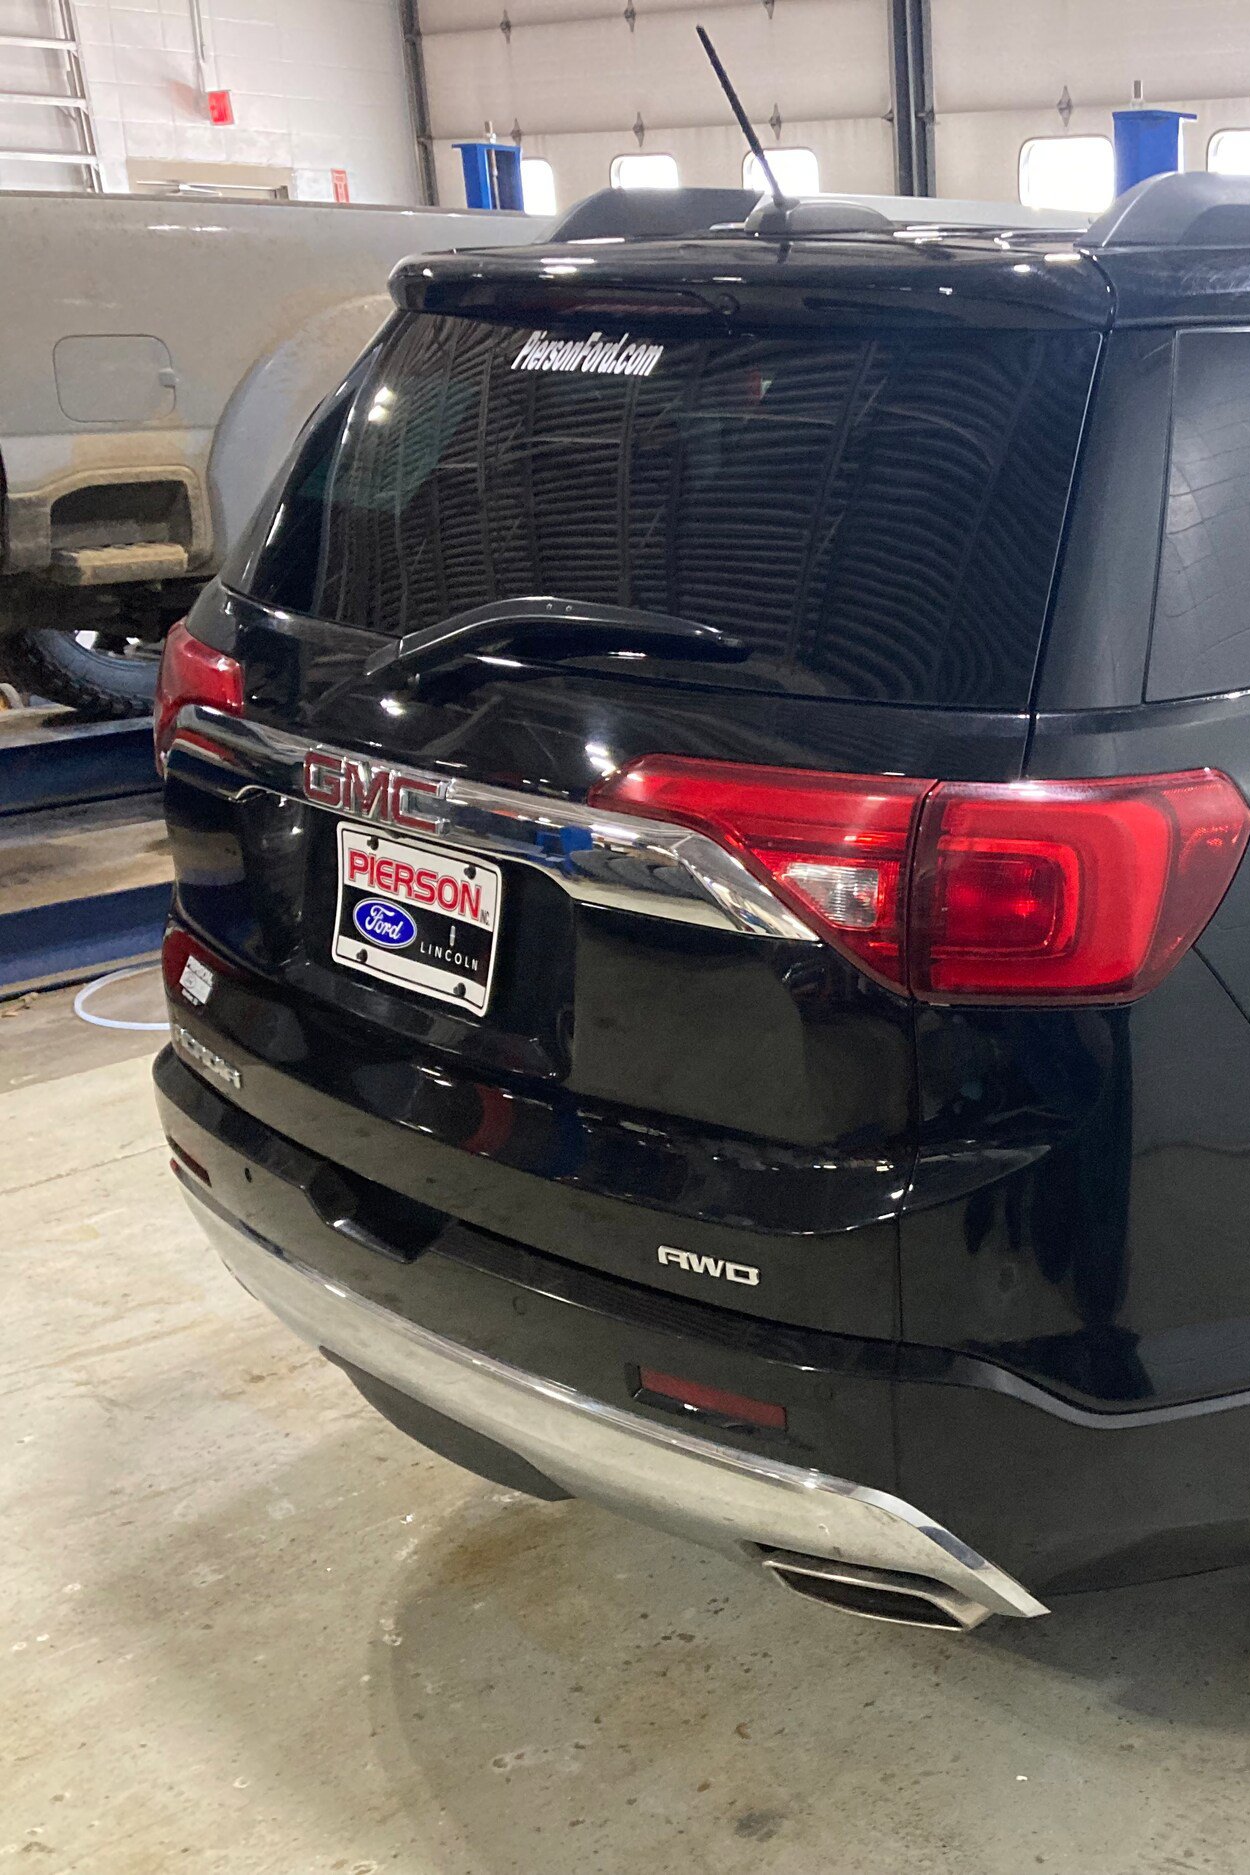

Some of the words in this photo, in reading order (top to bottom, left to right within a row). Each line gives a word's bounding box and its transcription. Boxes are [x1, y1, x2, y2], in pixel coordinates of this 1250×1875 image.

[511, 330, 663, 376] PiersonFord.com
[303, 751, 450, 836] GMC
[348, 847, 482, 921] PIERSON
[364, 904, 404, 940] Ford
[420, 941, 479, 971] LINCOLN
[657, 1245, 760, 1286] AWD
